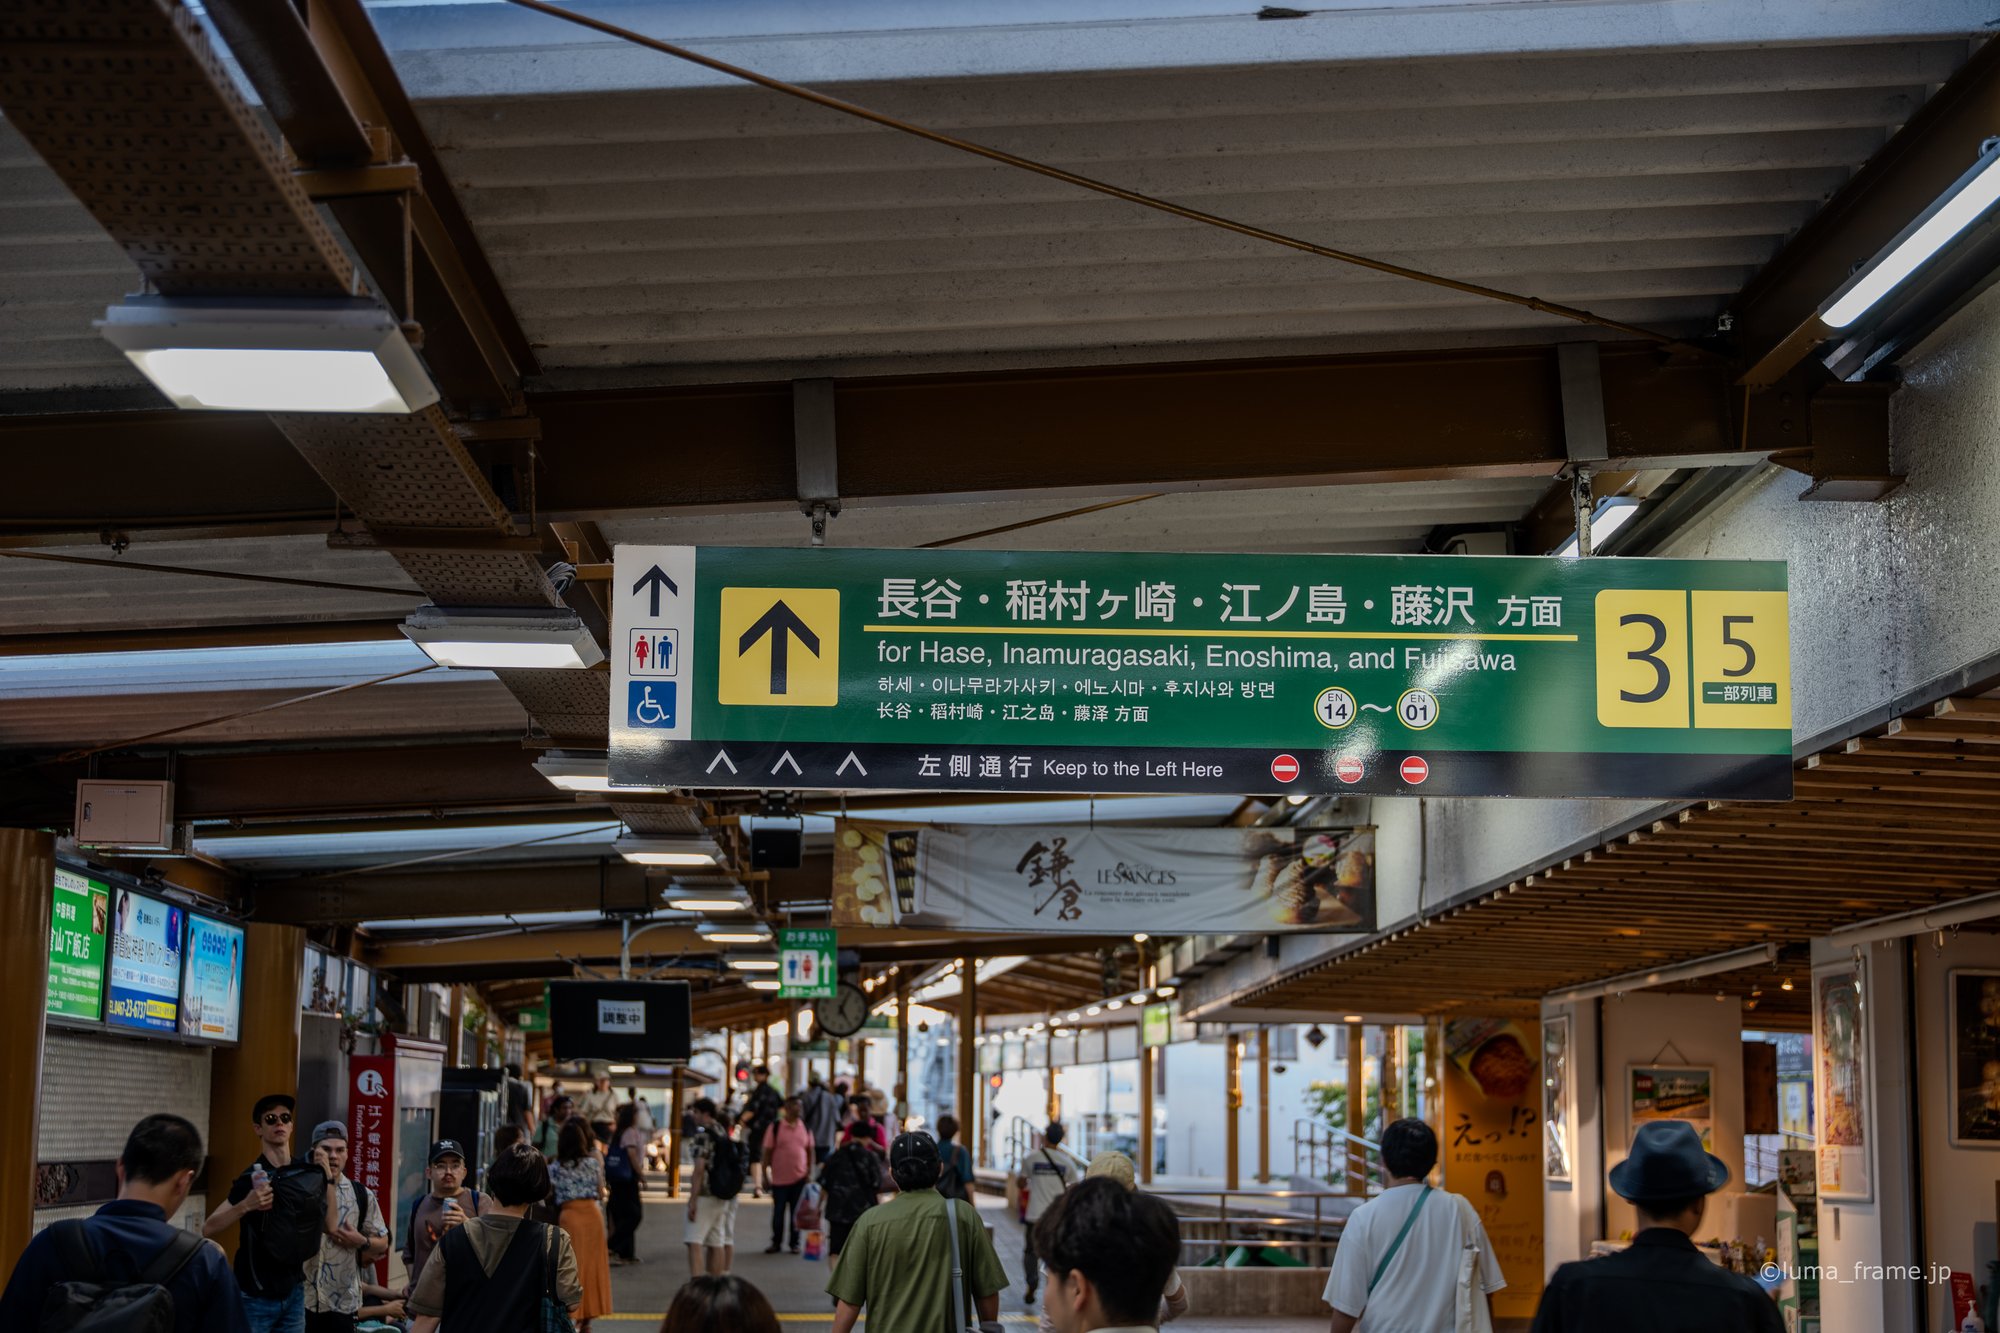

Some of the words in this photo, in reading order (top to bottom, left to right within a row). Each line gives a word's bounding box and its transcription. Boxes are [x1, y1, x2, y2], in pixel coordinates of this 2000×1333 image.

[1498, 595, 1562, 627] 方面
[1722, 615, 1756, 677] 5
[878, 640, 911, 662] for
[921, 641, 992, 667] Hase,
[1004, 642, 1195, 671] Inamuragasaki,
[1207, 645, 1339, 671] Enoshima,
[1349, 648, 1395, 669] and
[1405, 648, 1516, 672] Fujisawa
[1620, 613, 1671, 704] 3
[1241, 681, 1275, 698] 방면
[1328, 693, 1343, 702] EN
[1411, 694, 1426, 703] EN
[1707, 685, 1773, 702] 一部列車
[1115, 705, 1149, 723] 方面
[1324, 703, 1347, 720] 14
[1405, 704, 1428, 721] 01
[918, 755, 1032, 778] 左側通行
[1044, 759, 1088, 779] Keep
[1093, 761, 1108, 776] to
[1112, 761, 1140, 777] the
[1145, 761, 1177, 777] Left
[1183, 761, 1223, 777] Here
[1016, 837, 1082, 920] 鎌倉
[786, 931, 831, 942] お手洗い
[603, 1012, 641, 1025] 調整中
[356, 1104, 366, 1139] Enoden
[352, 1141, 365, 1182] Neighbo
